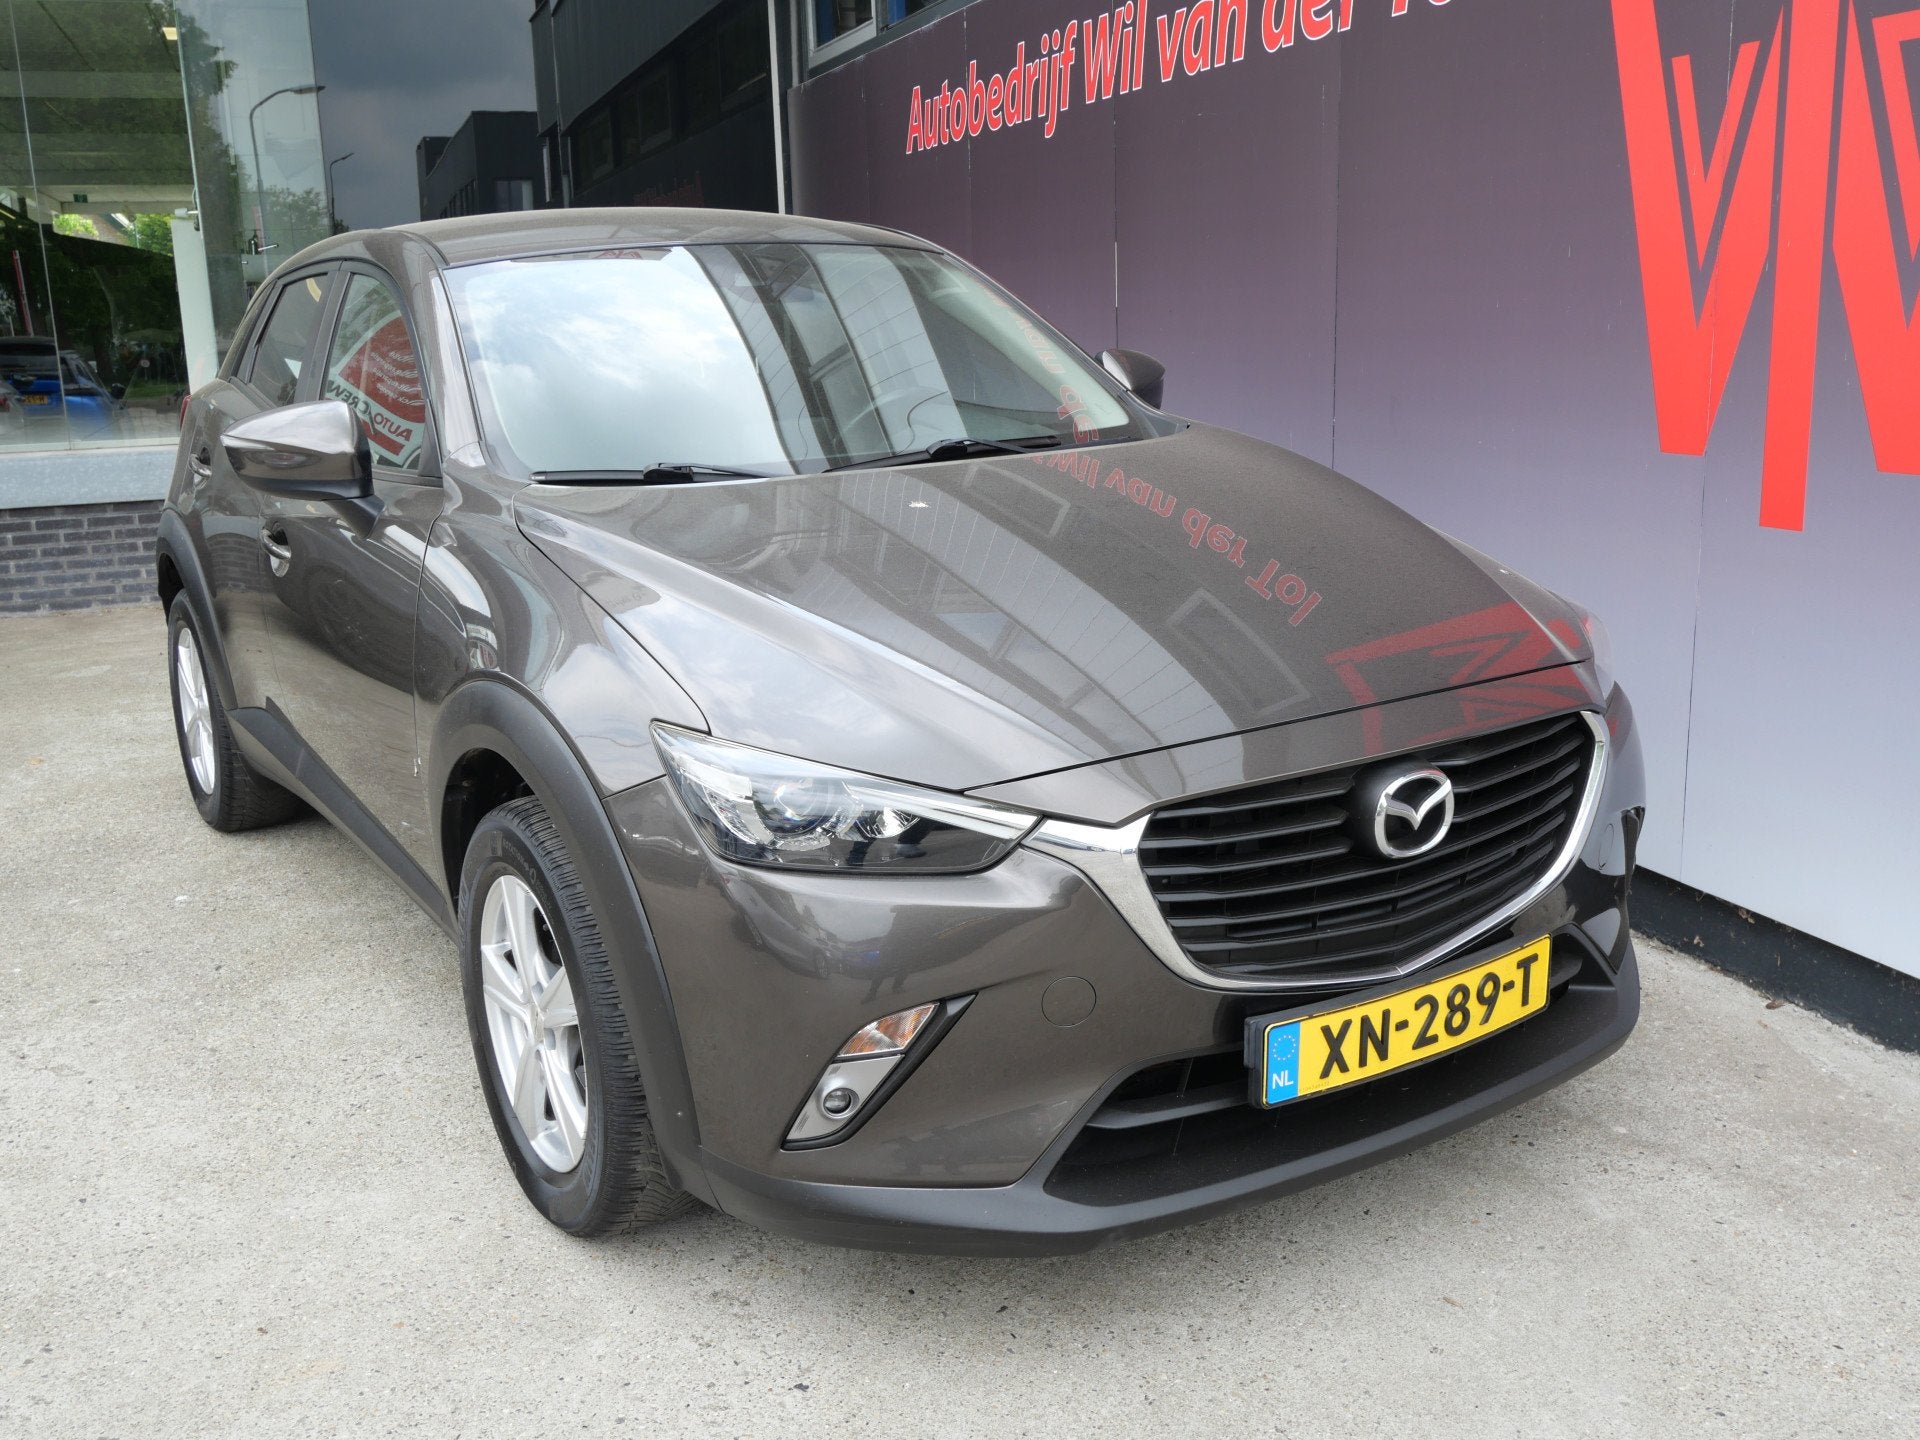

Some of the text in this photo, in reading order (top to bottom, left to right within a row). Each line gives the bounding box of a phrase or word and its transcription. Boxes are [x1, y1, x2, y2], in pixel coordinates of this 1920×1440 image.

[906, 20, 1077, 154] Autobedrijf
[1083, 0, 1147, 104] Wil
[1157, 0, 1248, 83] van
[1272, 1070, 1294, 1089] NL
[1319, 952, 1539, 1080] XN-289-T
